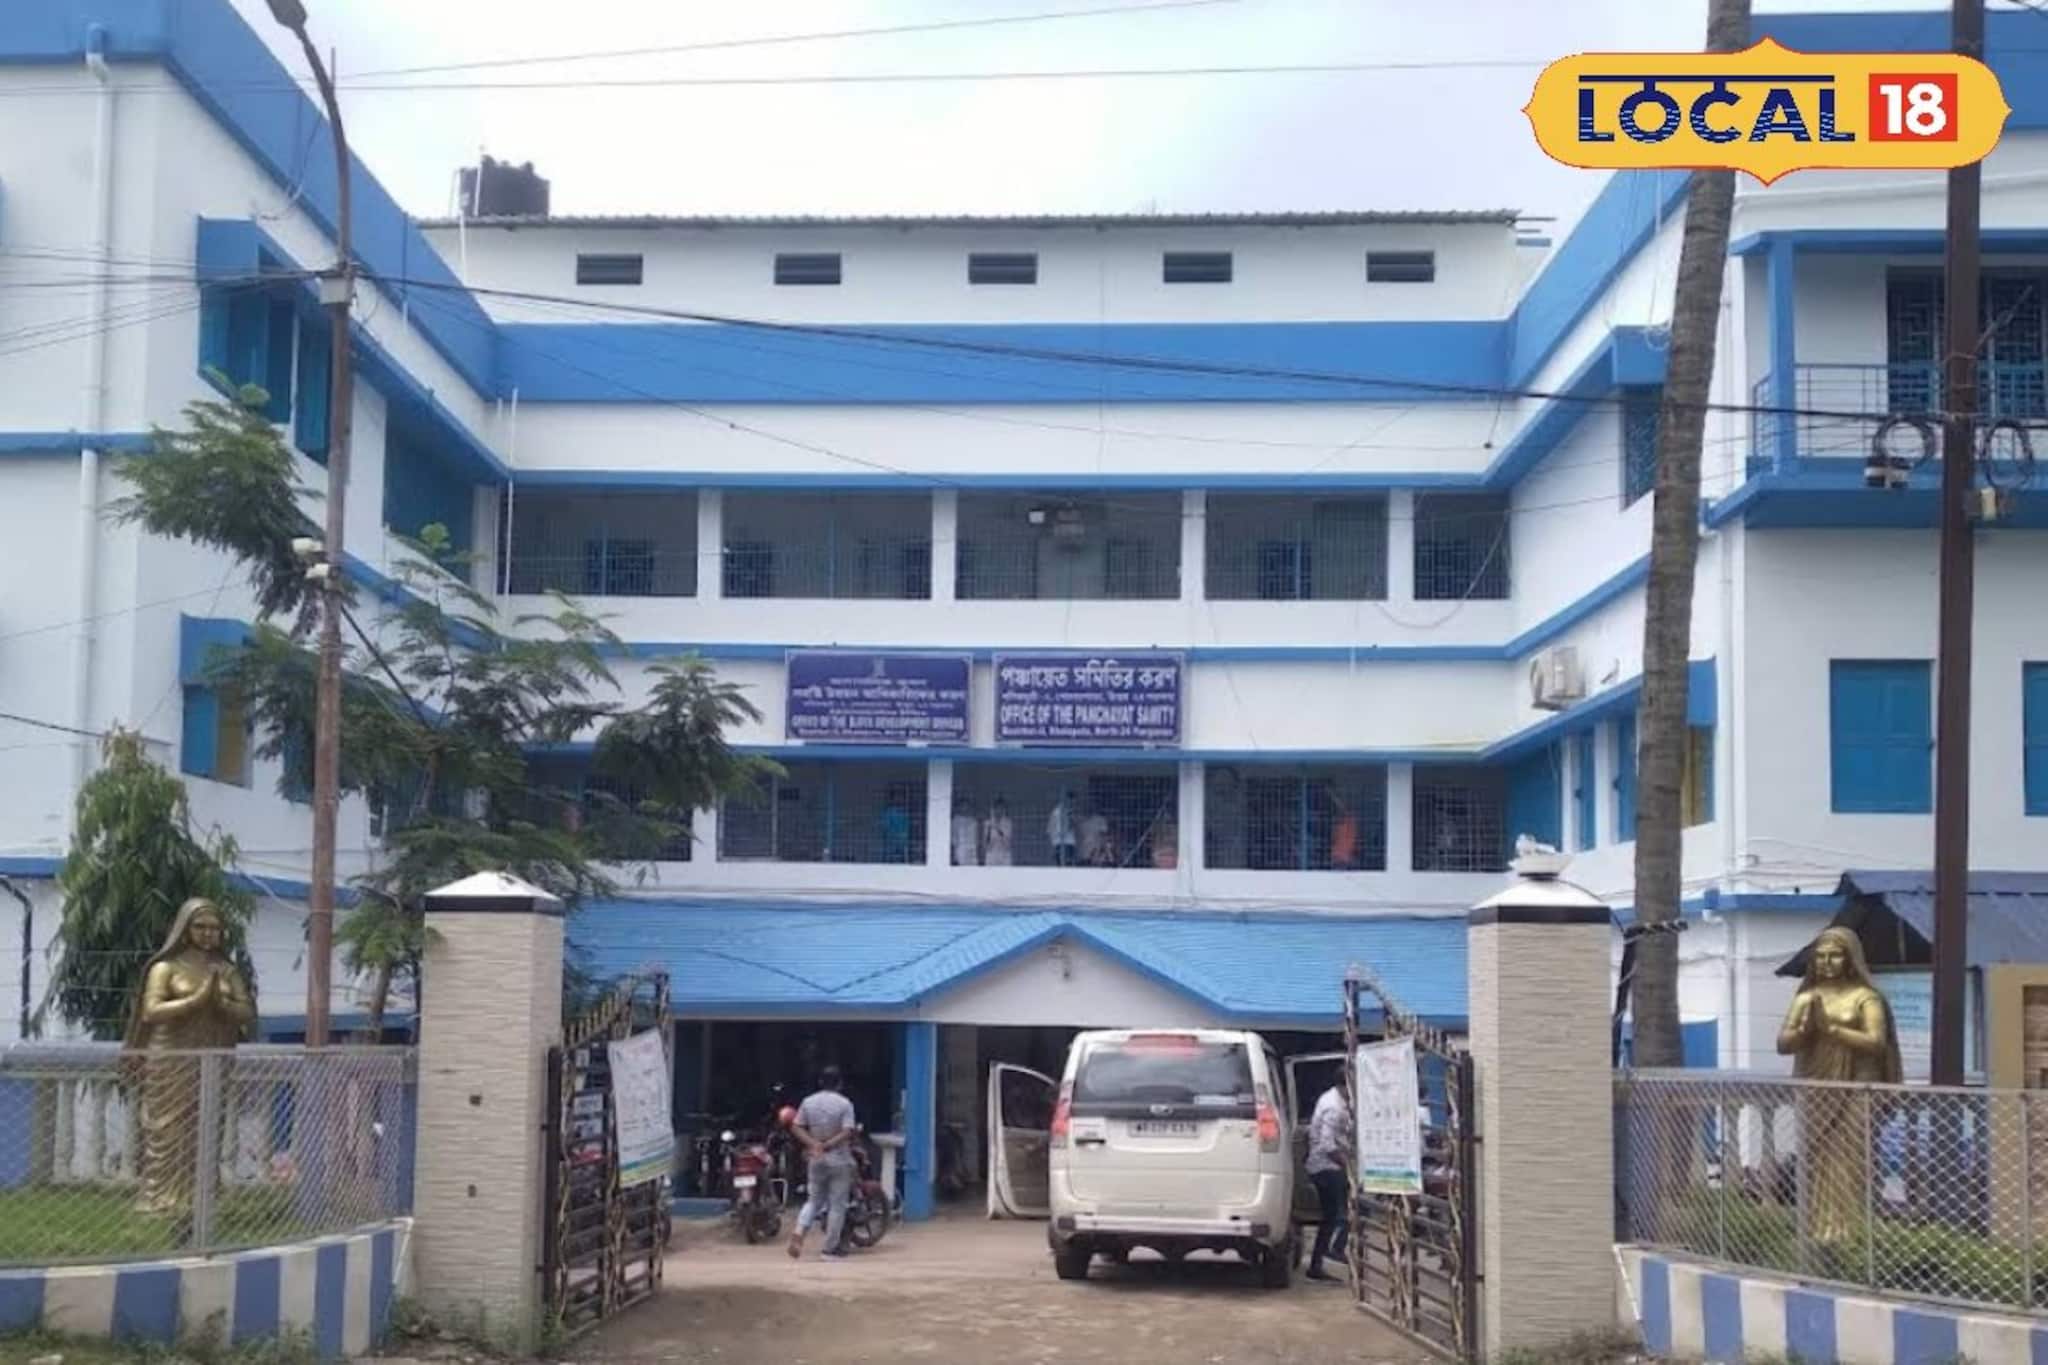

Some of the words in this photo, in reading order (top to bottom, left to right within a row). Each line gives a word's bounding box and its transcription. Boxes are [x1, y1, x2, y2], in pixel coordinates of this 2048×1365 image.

[1001, 666, 1068, 688] পঞ্চায়েত
[1073, 659, 1134, 689] সমিতির
[1137, 667, 1176, 688] করণ
[1001, 704, 1036, 725] OFFICE
[1037, 705, 1051, 725] OF
[1053, 705, 1074, 725] THE
[1075, 705, 1134, 726] PANCHAYAT
[1137, 706, 1175, 726] SAMITY
